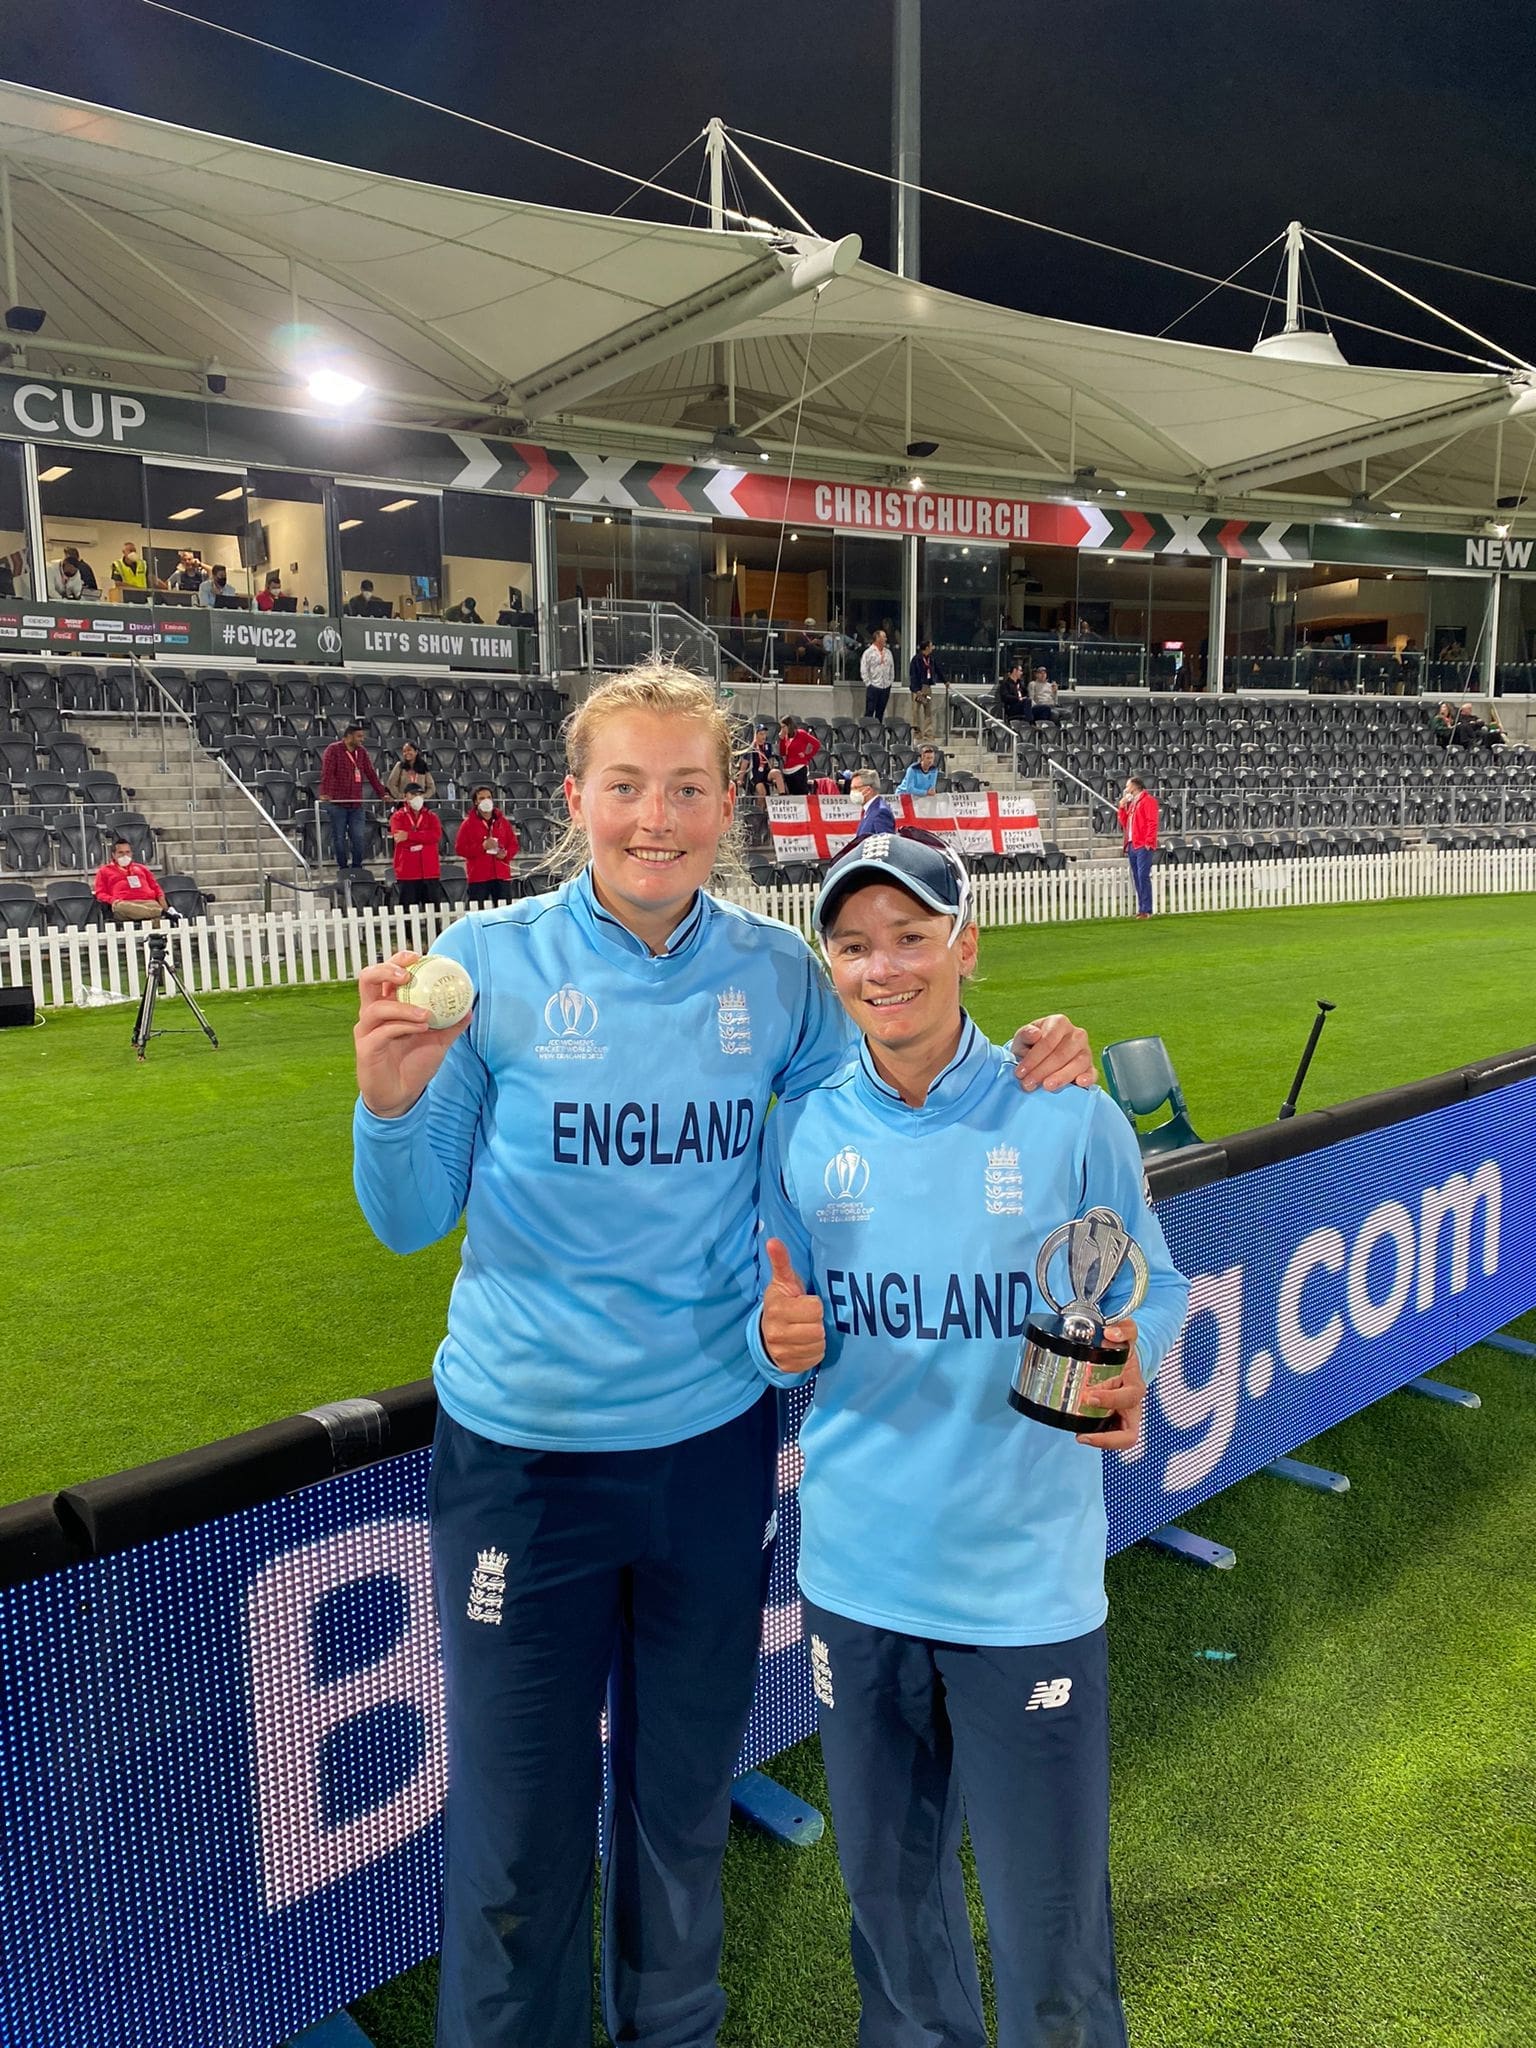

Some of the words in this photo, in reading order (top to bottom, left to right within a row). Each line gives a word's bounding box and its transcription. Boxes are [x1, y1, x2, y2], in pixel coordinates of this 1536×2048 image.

[13, 384, 146, 441] CUP
[815, 485, 1030, 538] CHRISTCHURCH
[1466, 539, 1534, 568] NEW
[364, 631, 410, 652] LET'S
[418, 634, 463, 655] SHOW
[471, 637, 513, 658] THEM
[553, 1098, 753, 1166] ENGLAND
[826, 1269, 1032, 1340] ENGLAND
